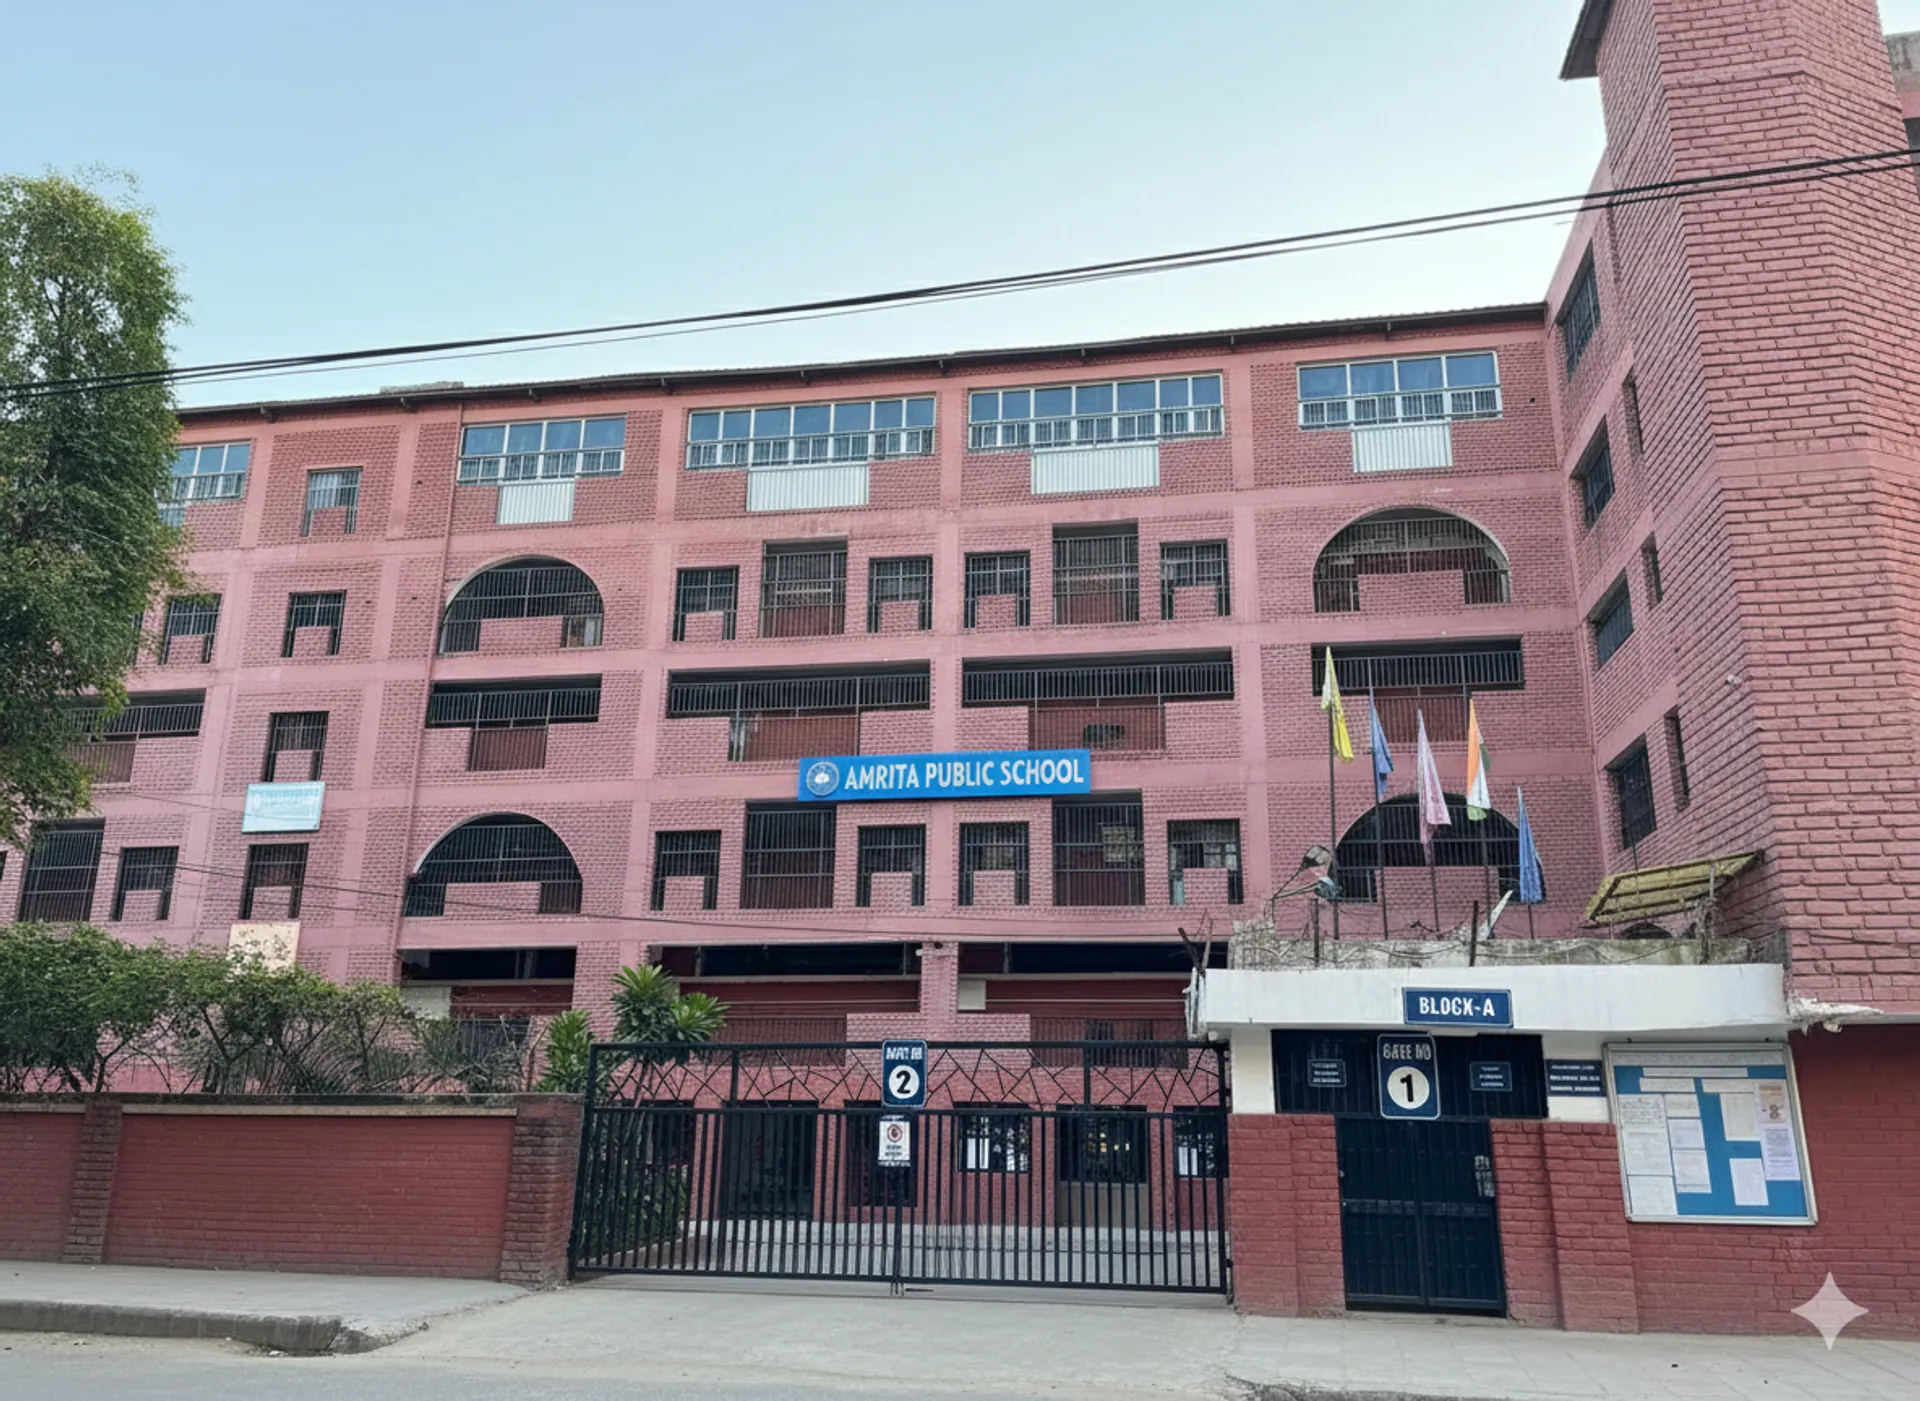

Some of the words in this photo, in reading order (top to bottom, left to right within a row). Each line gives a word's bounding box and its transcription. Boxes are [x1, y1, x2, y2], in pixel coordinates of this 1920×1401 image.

[844, 764, 920, 790] AMRITA
[925, 761, 995, 788] PUBLIC
[1000, 759, 1084, 786] SCHOOL
[896, 1070, 911, 1094] 2
[1400, 1074, 1414, 1102] 1
